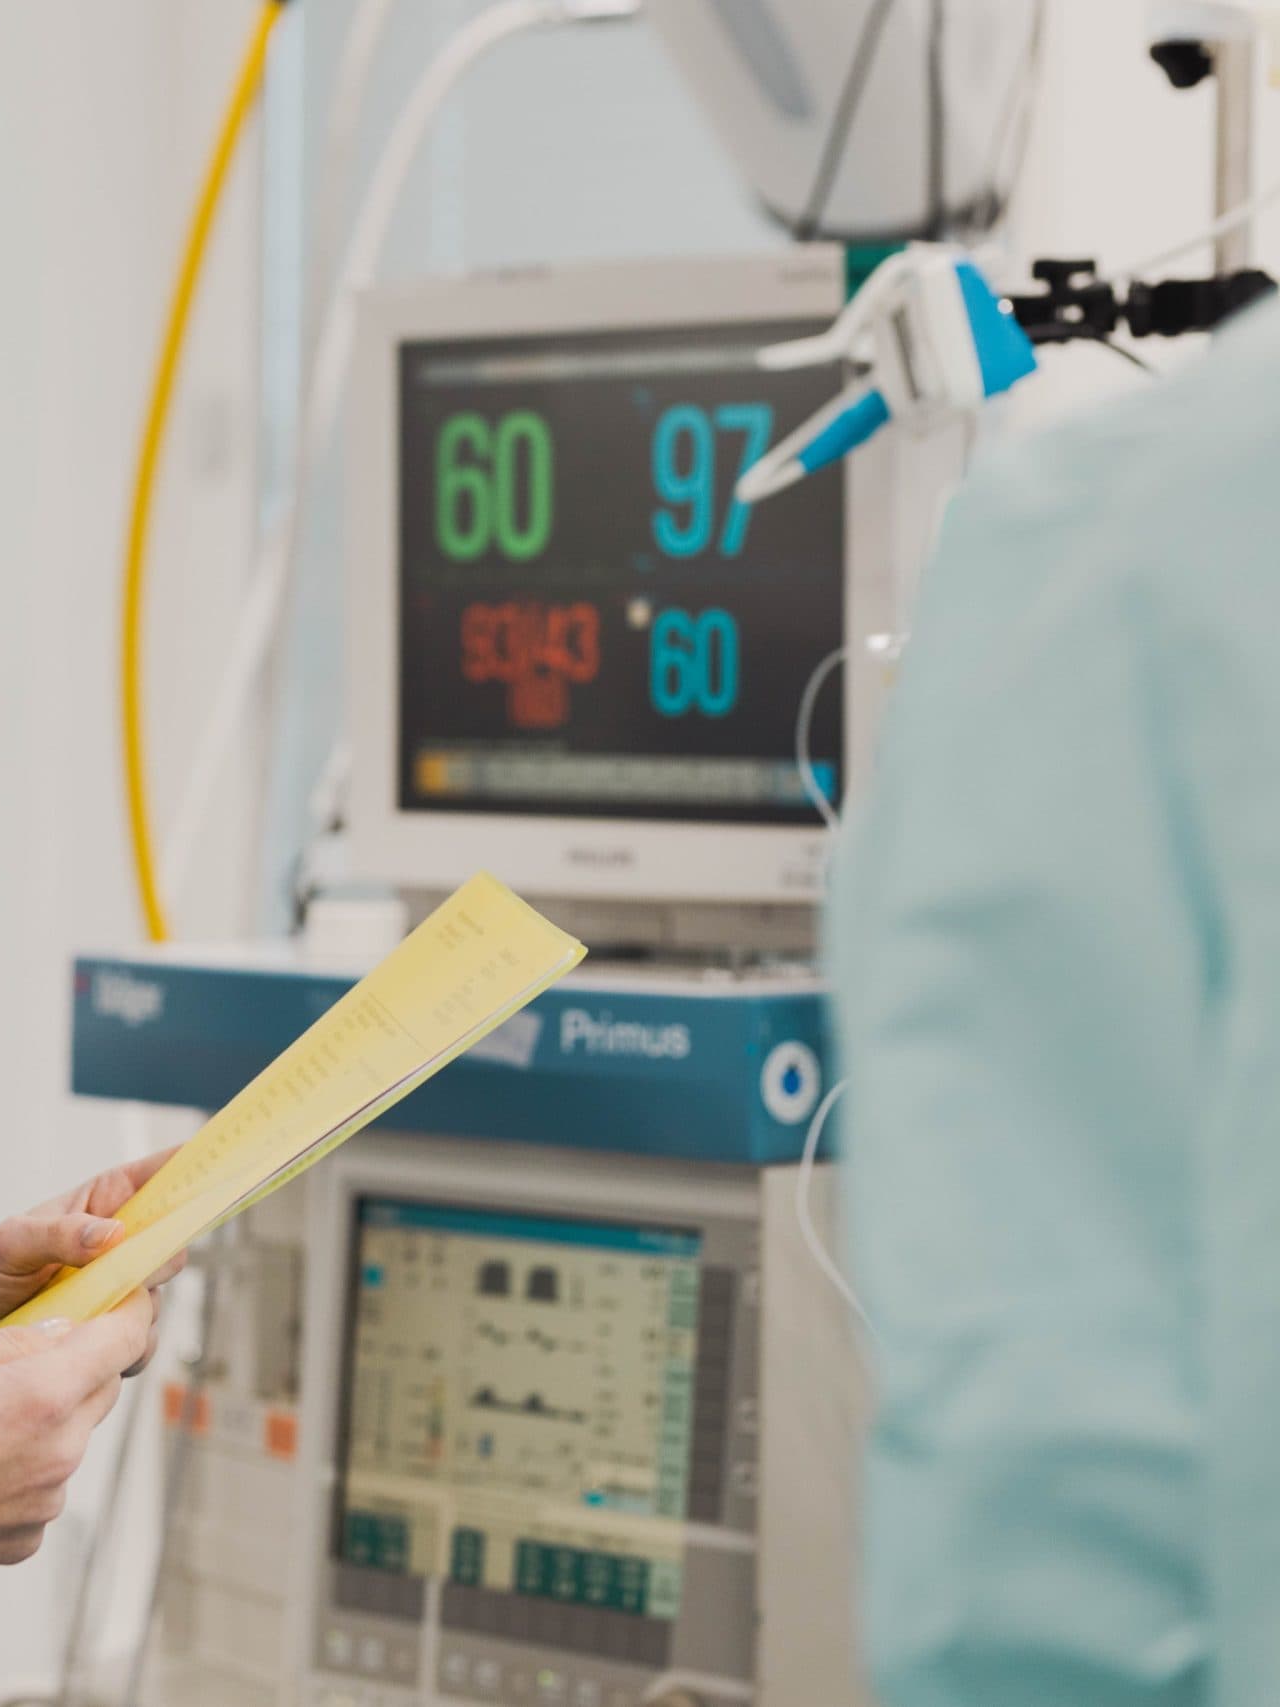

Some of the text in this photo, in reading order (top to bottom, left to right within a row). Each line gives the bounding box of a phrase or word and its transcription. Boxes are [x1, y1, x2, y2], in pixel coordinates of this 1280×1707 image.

[436, 411, 552, 560] 60
[650, 403, 775, 558] 97
[649, 608, 738, 716] 60
[560, 1008, 691, 1059] Primus
